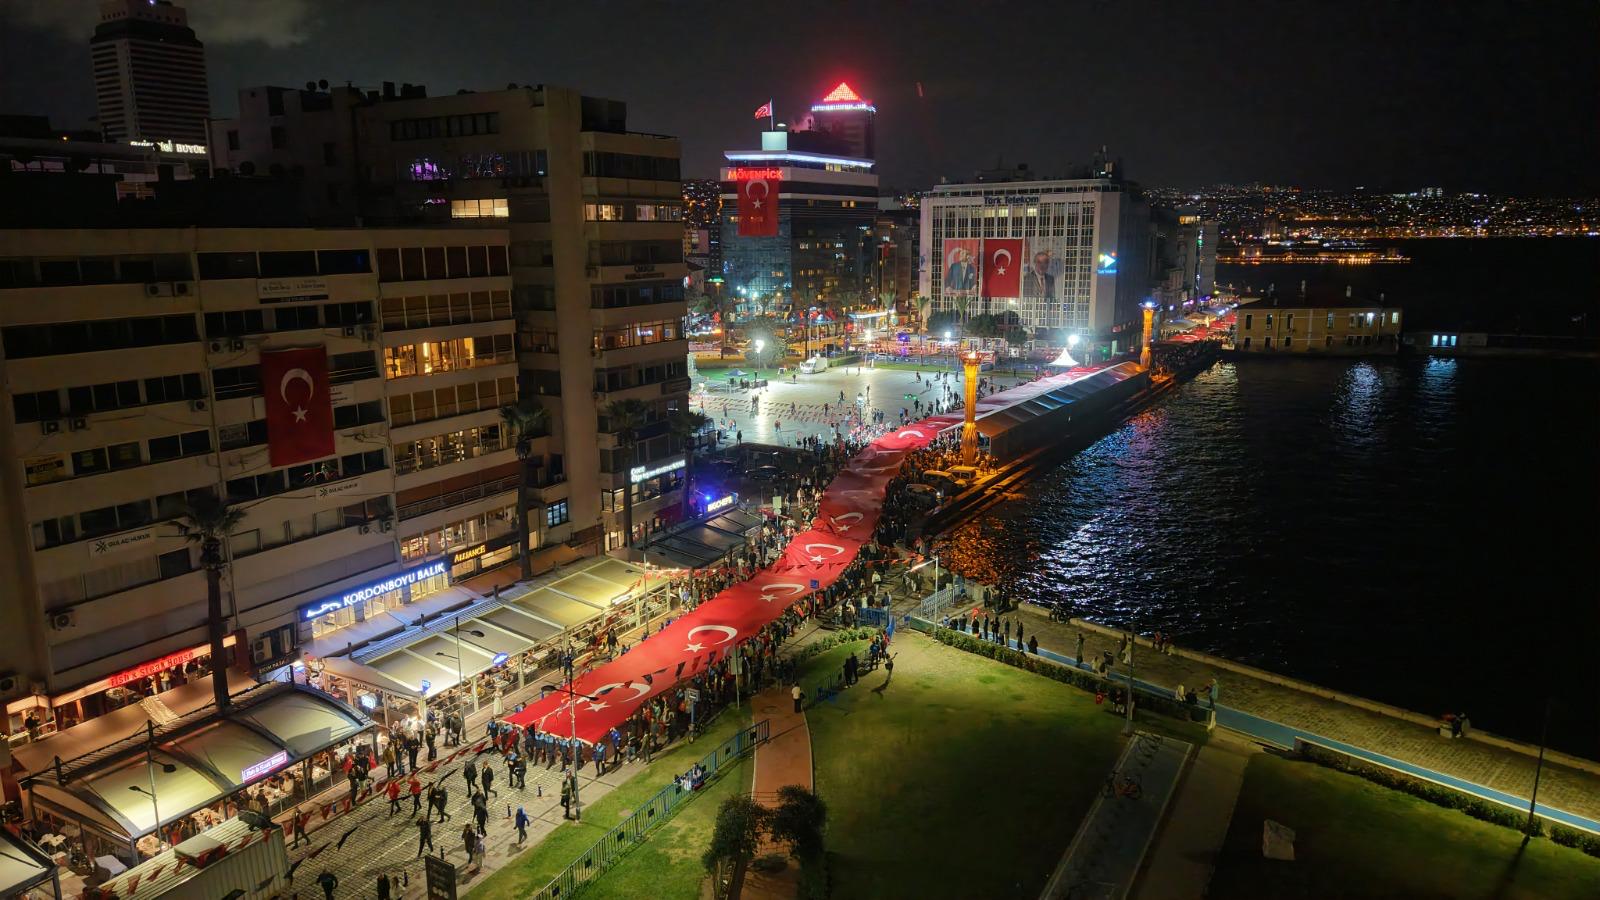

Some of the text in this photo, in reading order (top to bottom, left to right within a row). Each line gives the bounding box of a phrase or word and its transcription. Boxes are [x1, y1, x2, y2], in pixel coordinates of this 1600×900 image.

[984, 196, 1039, 205] Türk Telekom
[343, 562, 445, 607] KORDONBOYU BALIK
